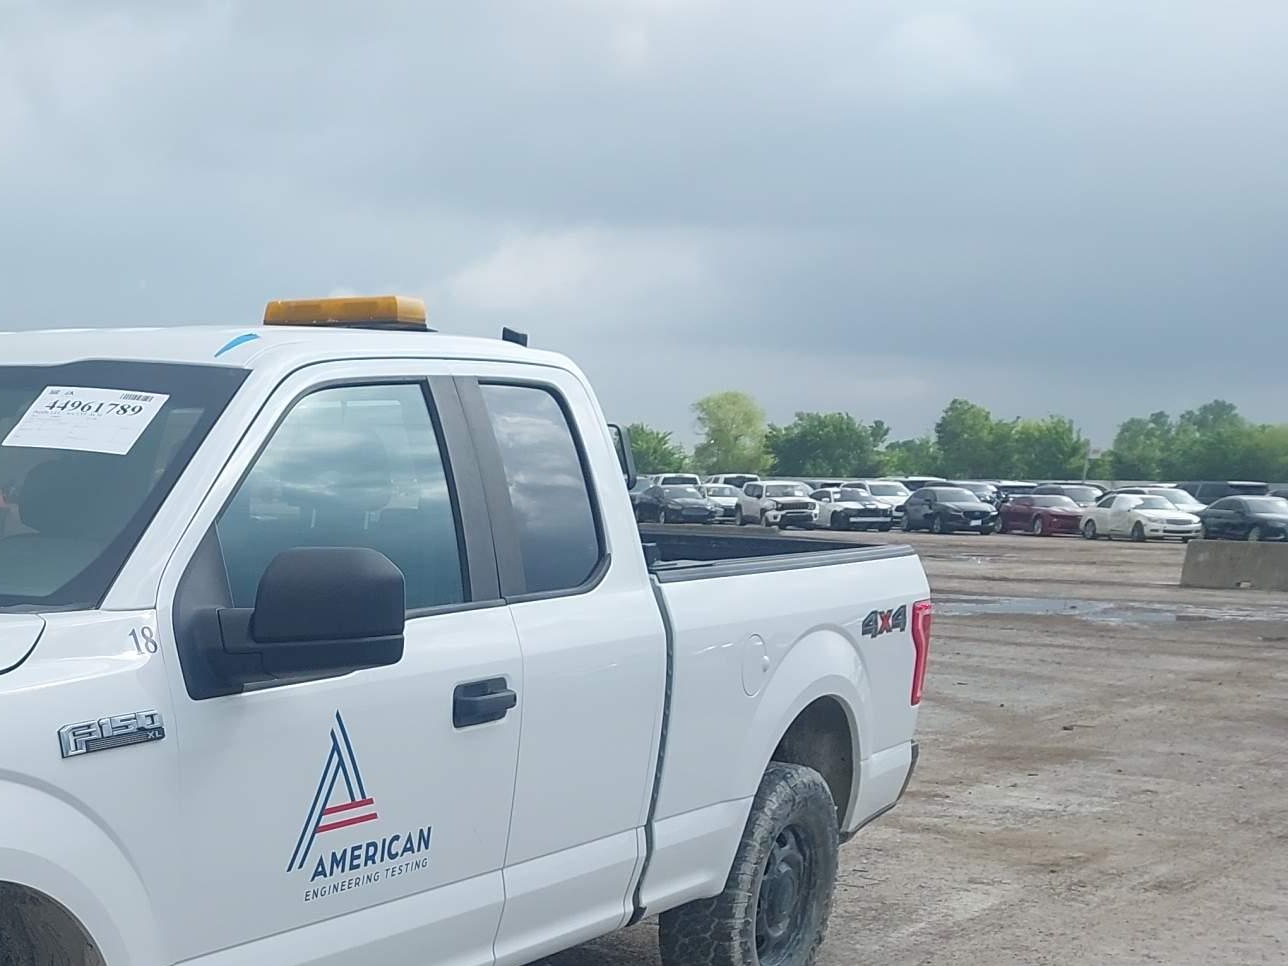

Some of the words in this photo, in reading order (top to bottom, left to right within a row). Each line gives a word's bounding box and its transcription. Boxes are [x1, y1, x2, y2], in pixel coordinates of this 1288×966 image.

[45, 399, 143, 416] 44961789
[128, 626, 158, 655] 18
[58, 709, 164, 758] F150
[146, 730, 162, 740] XL
[310, 826, 432, 883] AMERICAN
[304, 871, 380, 902] ENGINEERING
[384, 857, 429, 880] TESTING
